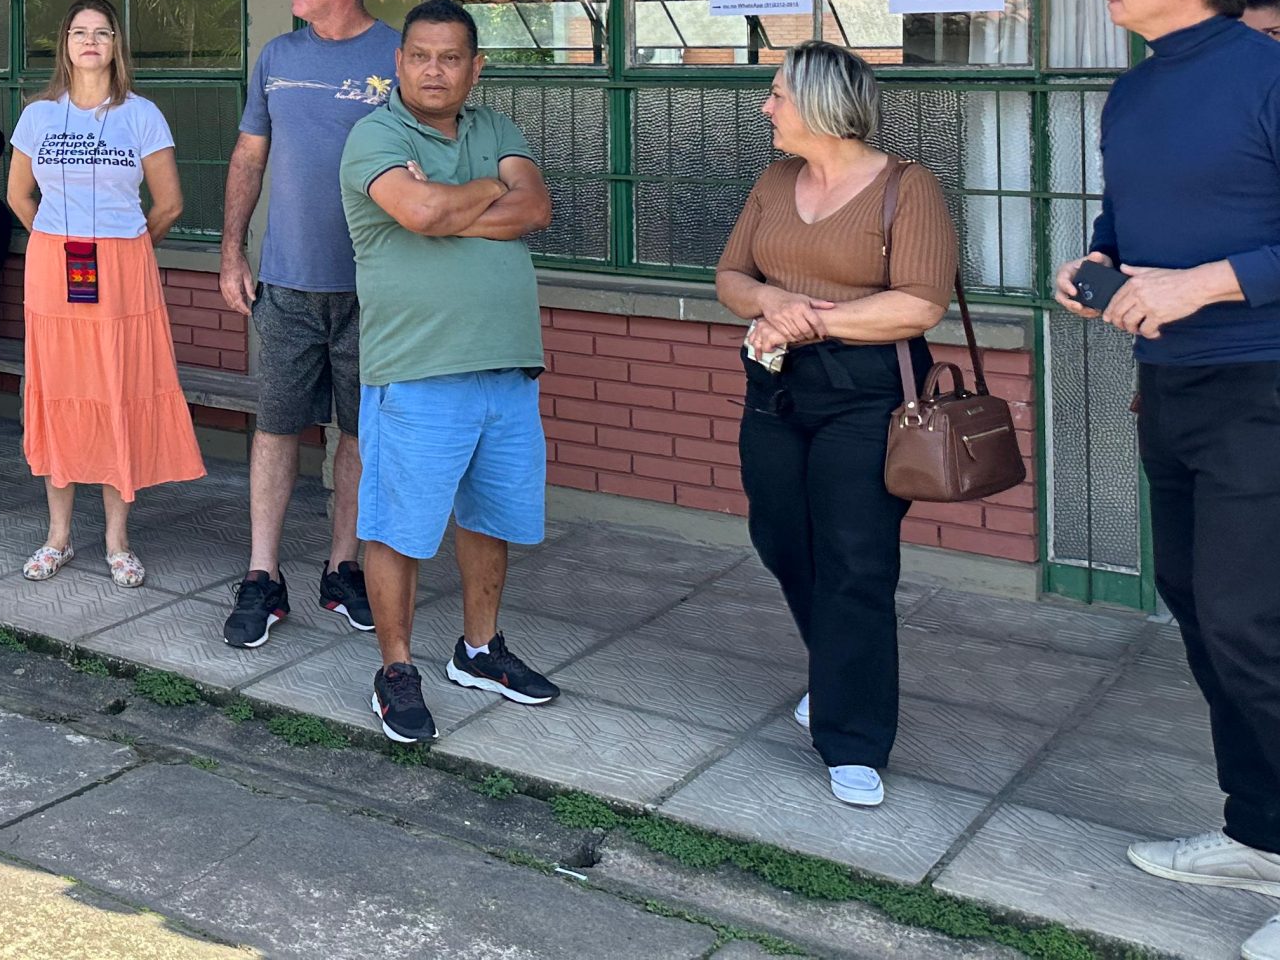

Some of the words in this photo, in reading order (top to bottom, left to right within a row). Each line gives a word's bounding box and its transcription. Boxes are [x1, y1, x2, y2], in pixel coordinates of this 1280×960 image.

[45, 132, 84, 140] Ladrão
[86, 132, 95, 140] &
[41, 140, 95, 149] Corrupto
[38, 146, 126, 157] Ex-presidiário
[128, 149, 135, 158] &
[37, 156, 137, 168] Descondenado.
